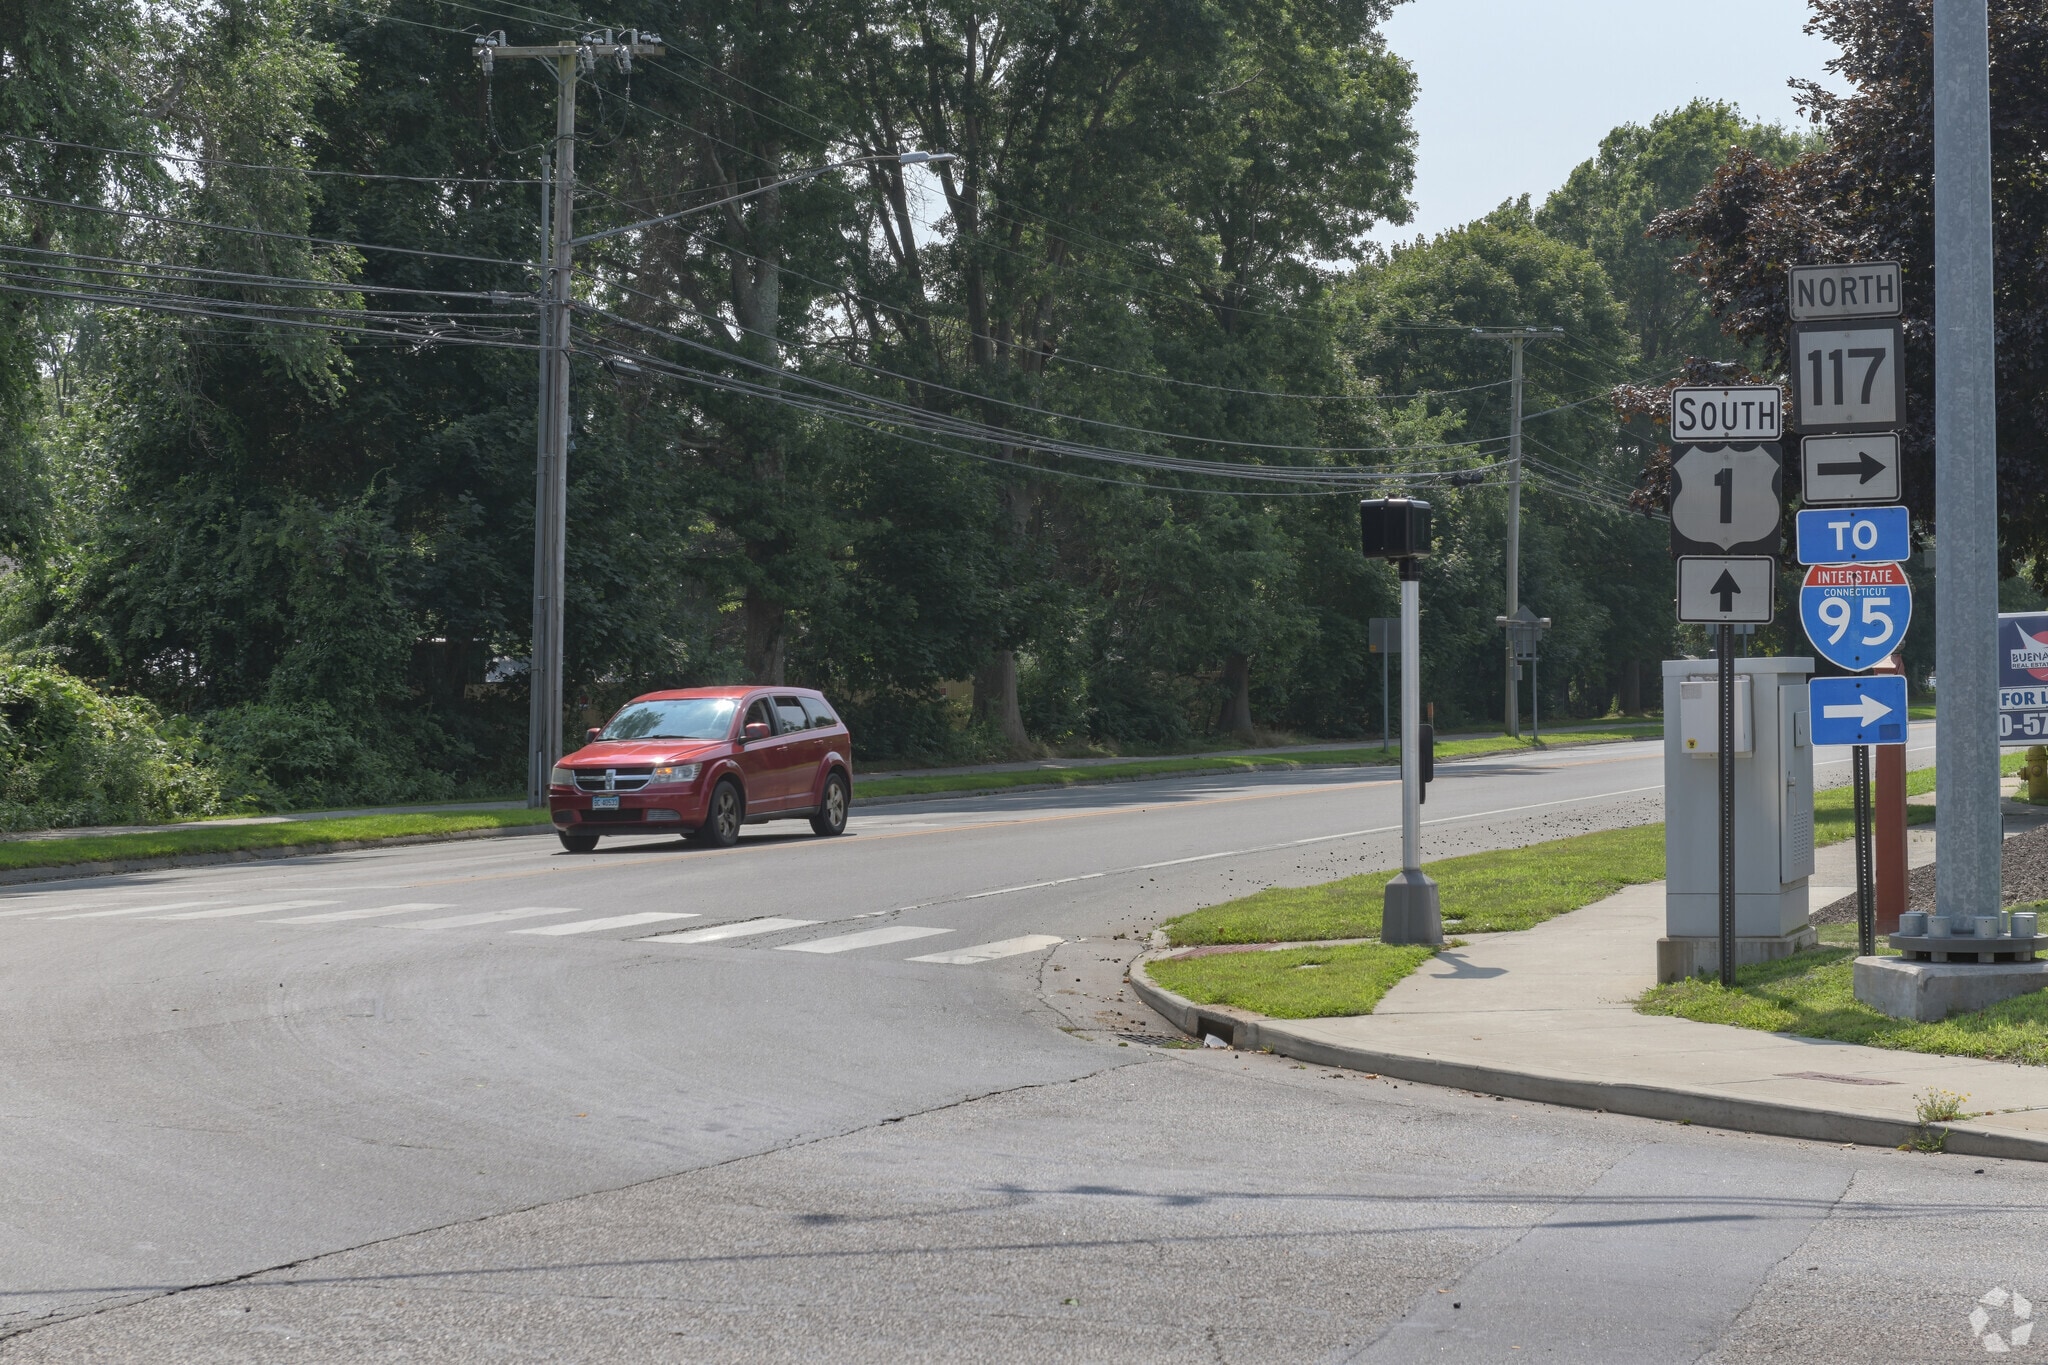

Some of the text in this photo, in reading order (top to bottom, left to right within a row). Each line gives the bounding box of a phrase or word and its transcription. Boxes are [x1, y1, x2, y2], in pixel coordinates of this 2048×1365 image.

[1798, 274, 1894, 308] NORTH
[1808, 347, 1886, 406] 117
[1679, 397, 1775, 431] SOUTH
[1714, 468, 1732, 523] 1
[1828, 520, 1878, 551] TO
[1817, 569, 1893, 584] INTERSTATE
[1823, 587, 1887, 597] CONNECTICUT
[1818, 596, 1894, 646] 95
[2001, 691, 2036, 706] FOR
